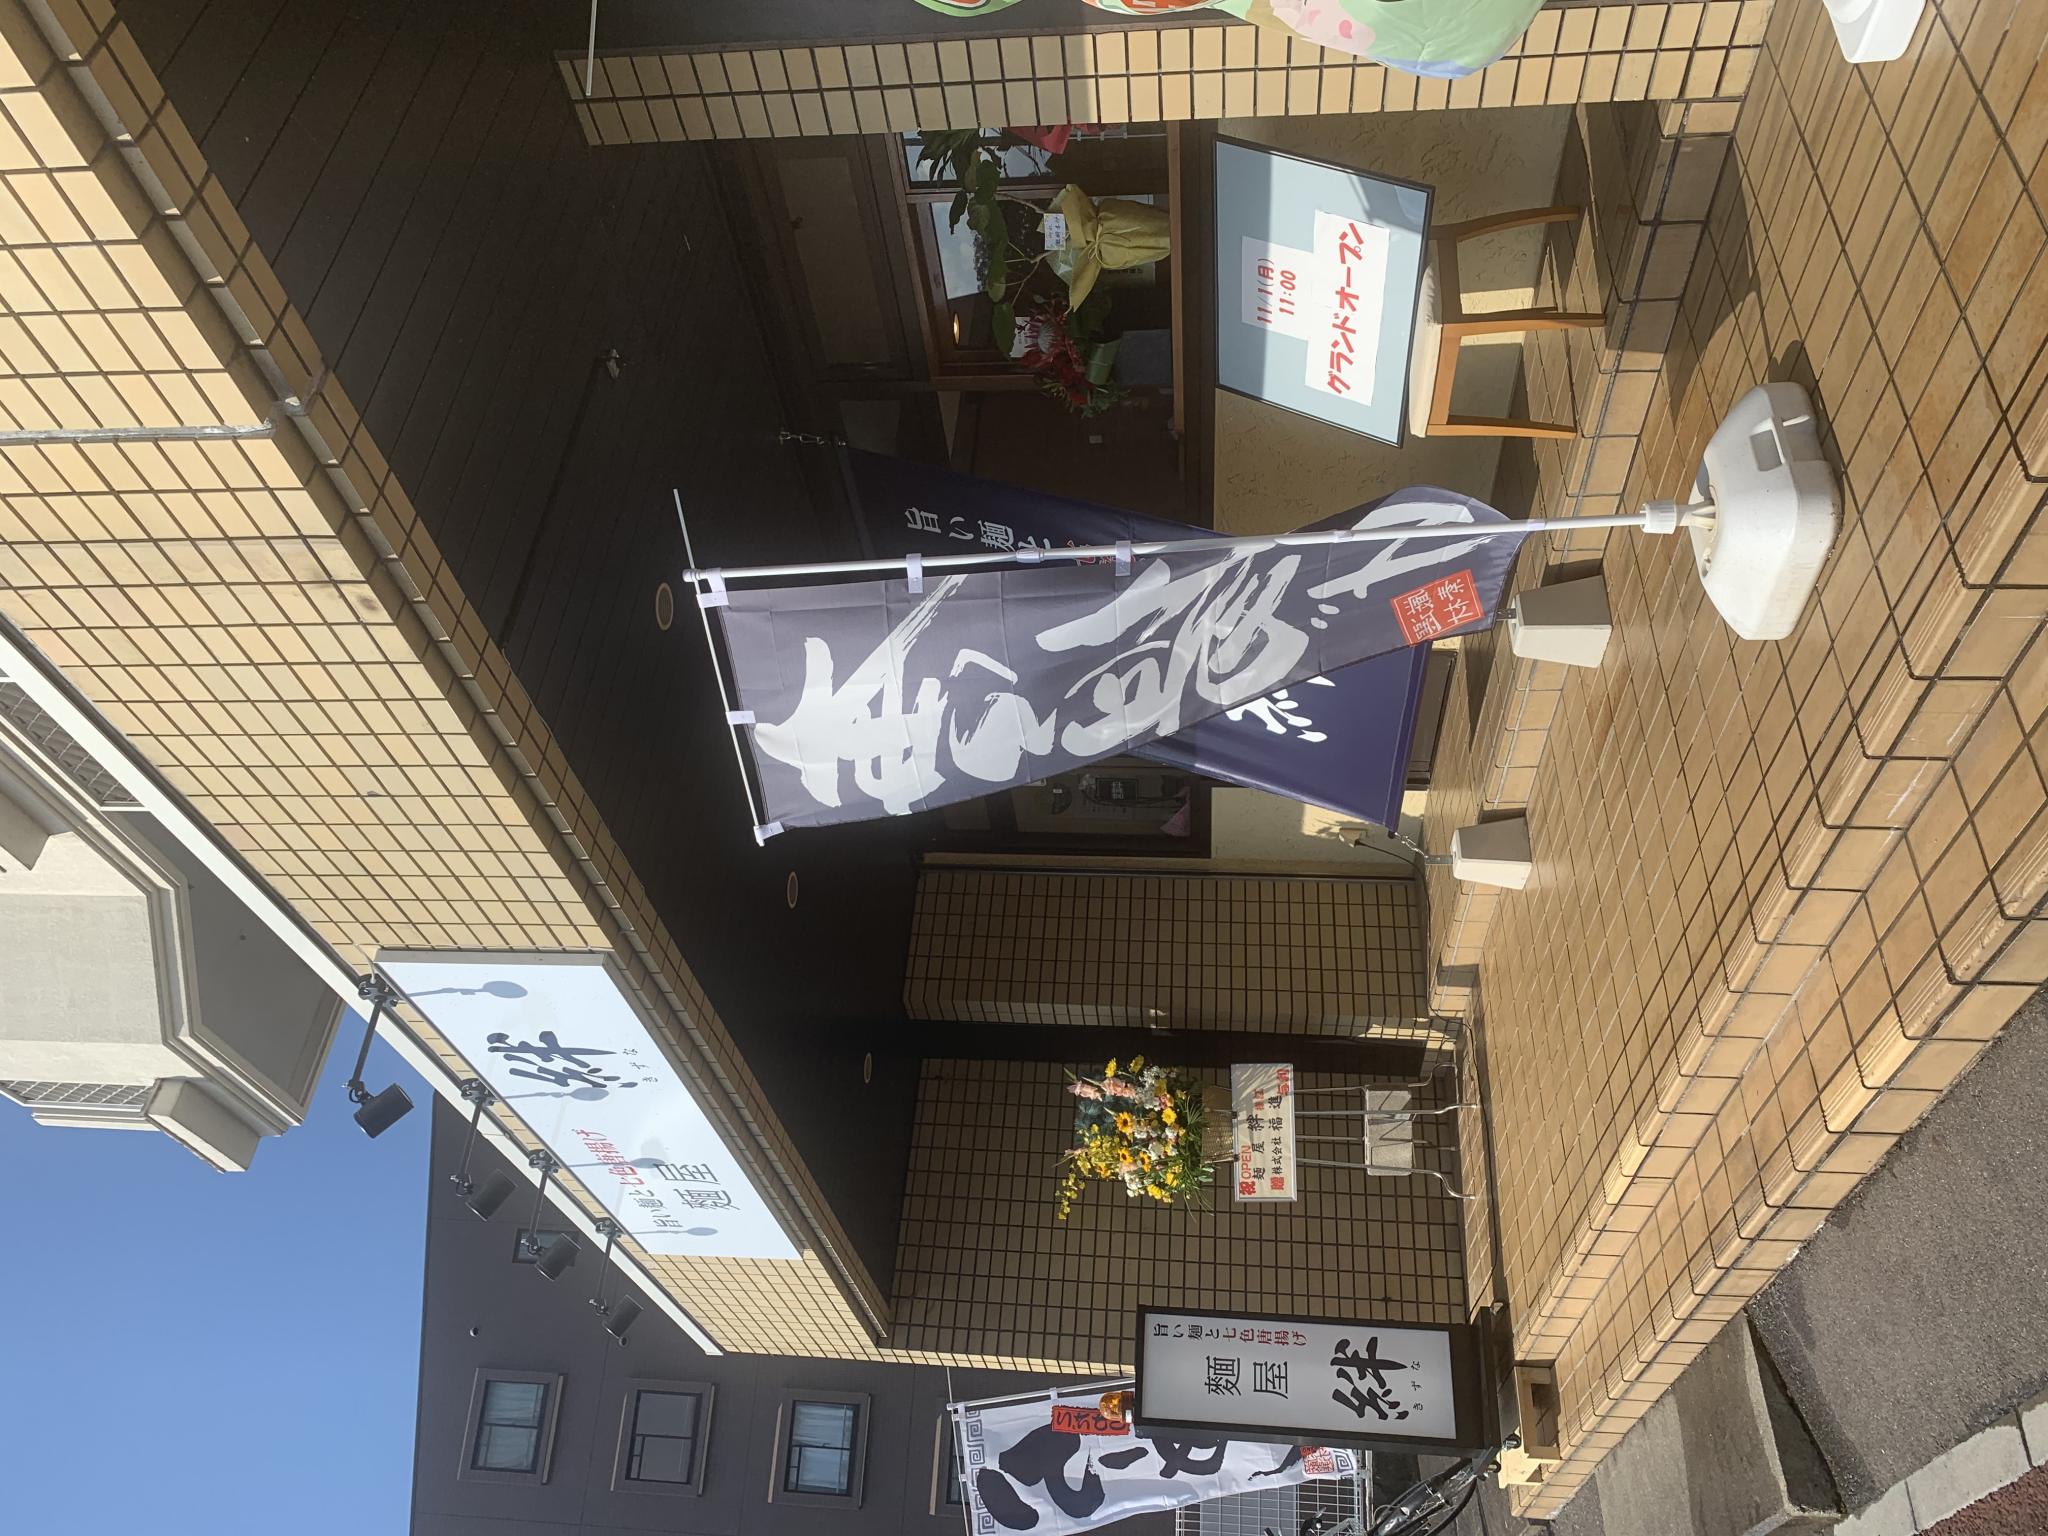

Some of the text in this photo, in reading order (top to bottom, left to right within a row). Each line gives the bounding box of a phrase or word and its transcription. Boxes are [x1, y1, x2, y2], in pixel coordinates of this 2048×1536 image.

[1279, 270, 1296, 316] 11:00
[1327, 221, 1364, 395] グランドオープン
[486, 1031, 638, 1088] 絆
[1241, 1145, 1252, 1179] OPEN
[1154, 1323, 1307, 1346] 旨い麺と七色唐揚げ
[1330, 1337, 1409, 1420] 絆
[1411, 1360, 1424, 1411] きずな
